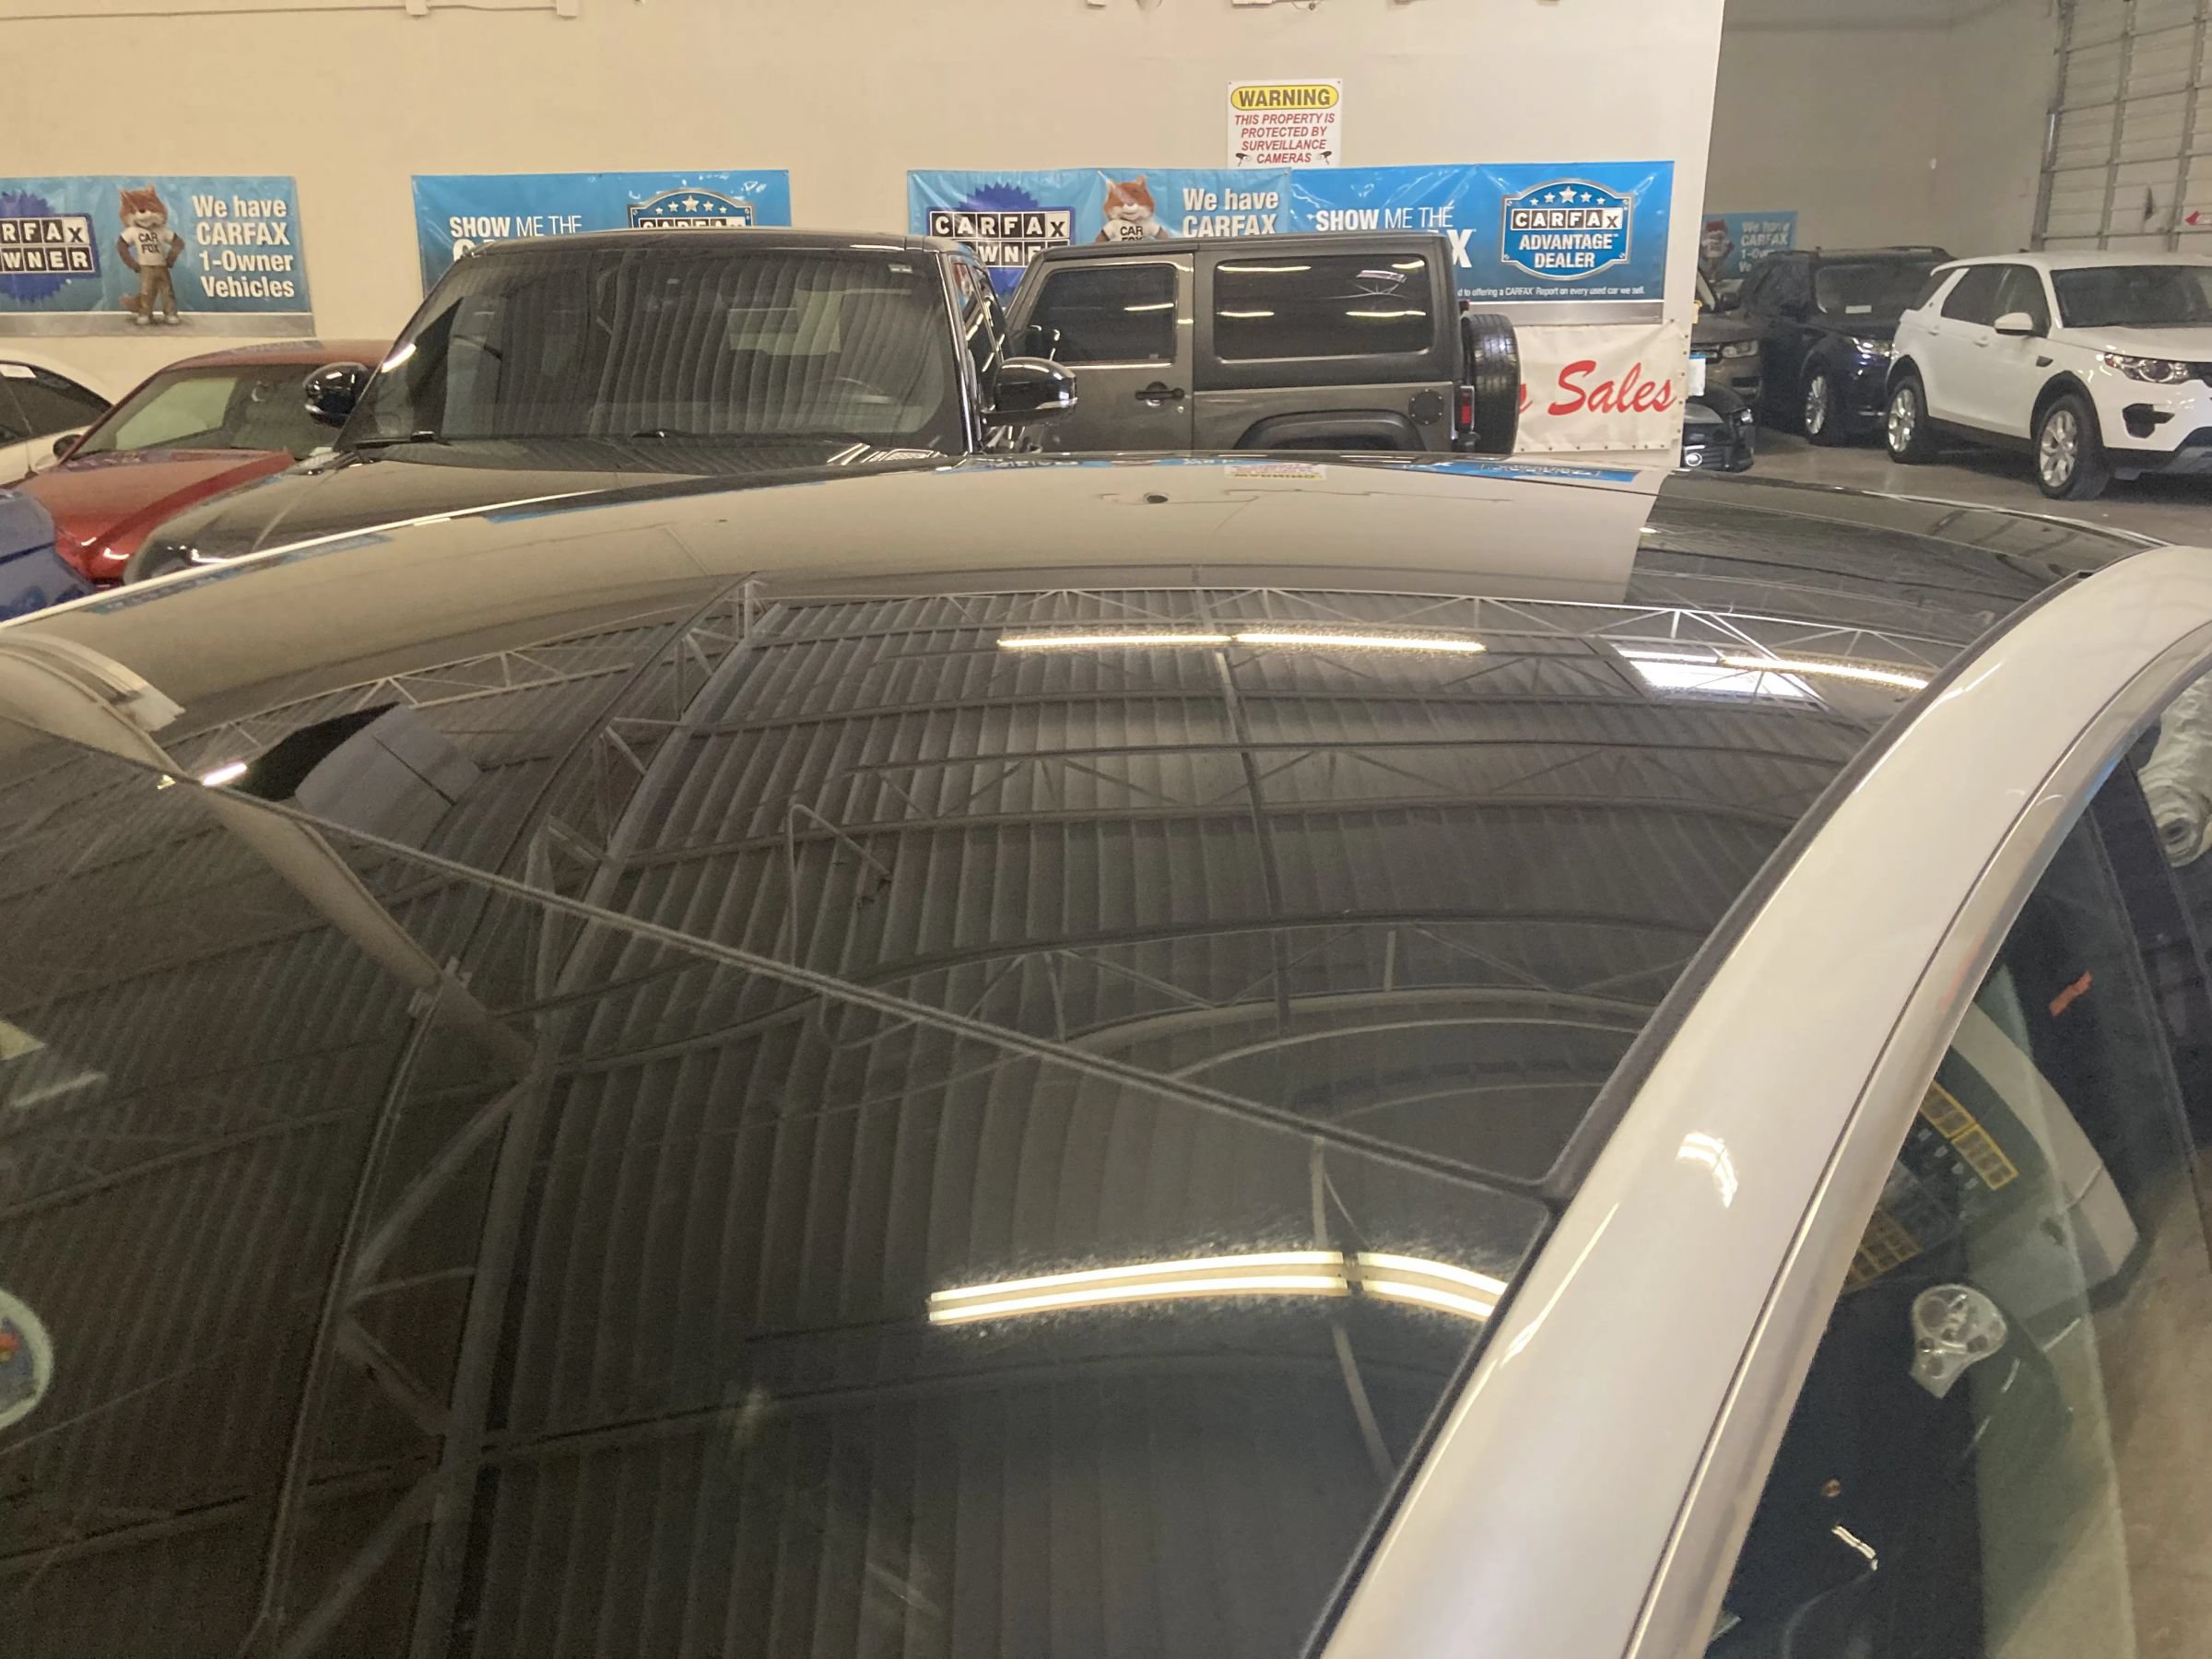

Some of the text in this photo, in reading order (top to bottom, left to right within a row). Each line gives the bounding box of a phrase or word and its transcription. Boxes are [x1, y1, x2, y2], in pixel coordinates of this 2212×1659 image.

[1239, 88, 1330, 107] WARNING
[1235, 112, 1335, 125] THIS PROPERTY IS
[1241, 126, 1327, 138] PROTECTED BY
[1241, 139, 1326, 151] SURVEILLANCE
[1256, 153, 1312, 164] CAMERAS
[192, 194, 287, 218] We have
[1182, 188, 1278, 211] We have
[935, 216, 1065, 237] CARFAX
[1183, 214, 1277, 238] CARFAX
[1315, 206, 1454, 230] SHOW ME THE
[1515, 211, 1618, 228] CARFAX
[196, 222, 290, 245] CARFAX
[449, 217, 511, 238] SHOW
[516, 217, 545, 237] ME
[1120, 226, 1143, 236] CAR
[139, 232, 159, 242] CAR
[1519, 233, 1613, 250] ADVANTAGE
[1741, 233, 1788, 246] CARFAX
[141, 243, 160, 253] FOX
[199, 250, 294, 272] 1-Owner
[1534, 252, 1595, 268] DEALER
[200, 276, 294, 298] Vehicles
[1472, 287, 1498, 297] offering
[1547, 360, 1677, 415] Sales
